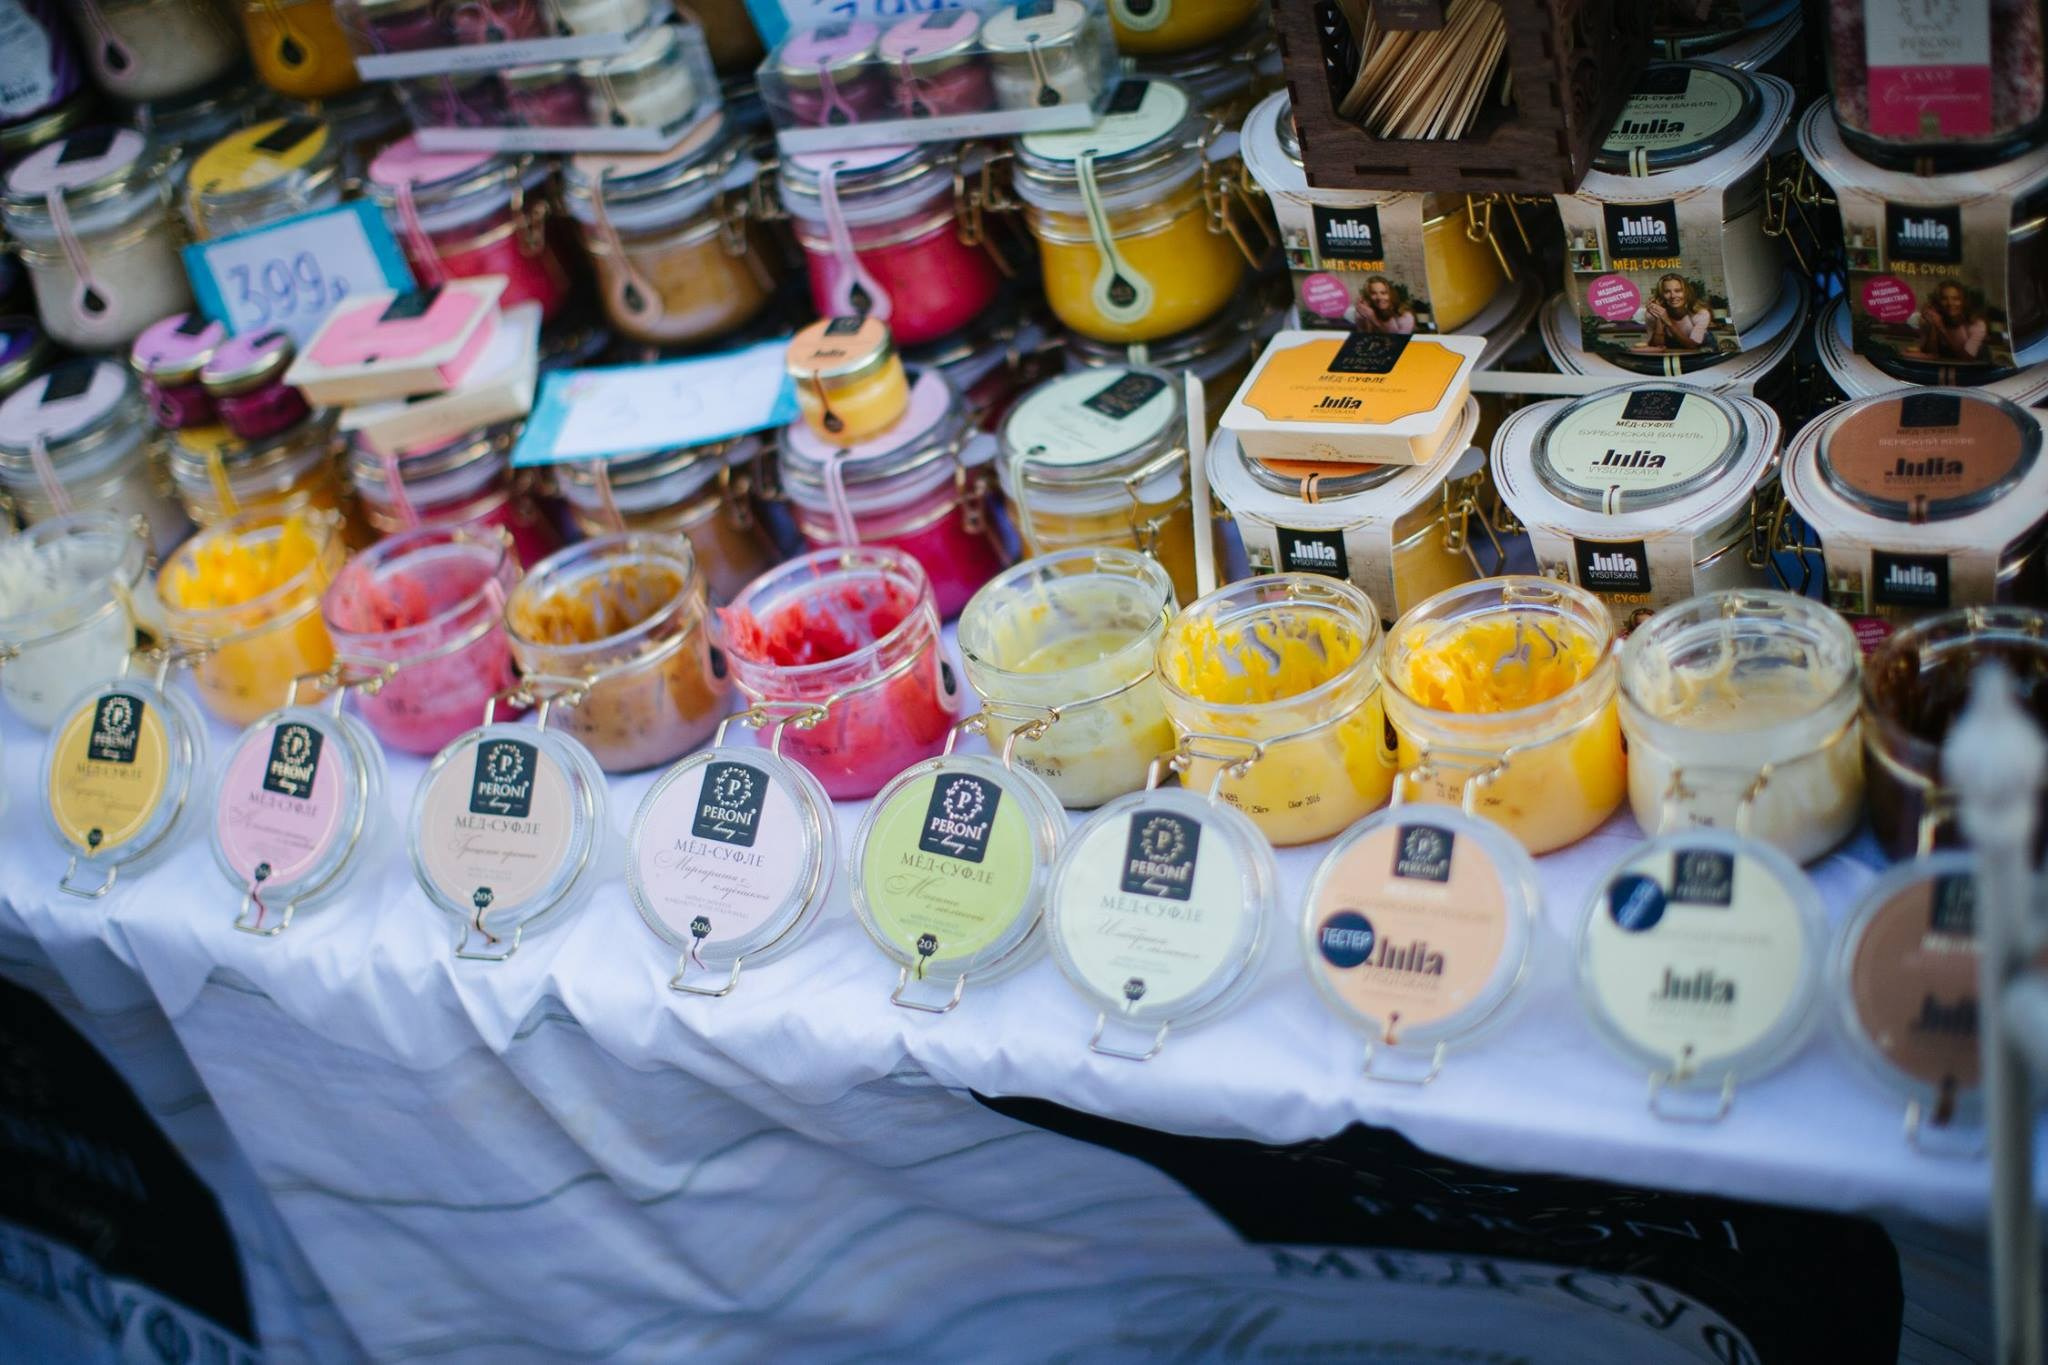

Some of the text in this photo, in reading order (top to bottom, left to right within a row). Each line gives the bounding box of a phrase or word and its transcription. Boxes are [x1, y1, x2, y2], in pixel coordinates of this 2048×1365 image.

[1611, 118, 1685, 134] Julia
[1326, 218, 1371, 239] Julia
[1617, 216, 1667, 236] Julia
[1898, 218, 1949, 240] Julia
[1618, 234, 1669, 245] VYSOTSKAYA
[228, 250, 326, 326] 399
[1313, 395, 1363, 409] Julia
[1592, 449, 1666, 468] Julia
[1884, 458, 1963, 476] Julia
[1588, 466, 1660, 476] VYSOTSKAYA
[1290, 540, 1337, 561] Julia
[1588, 552, 1638, 572] Julia
[1588, 570, 1639, 579] VYSOTSKAYA
[1884, 564, 1937, 588] Julia
[477, 781, 527, 799] PERONI
[702, 804, 753, 826] PERONI
[930, 816, 982, 840] PERONI
[1129, 859, 1188, 881] PERONI
[1322, 926, 1371, 949] ТЕСТЕР
[1364, 936, 1444, 976] Julia
[1650, 966, 1735, 1004] Julia
